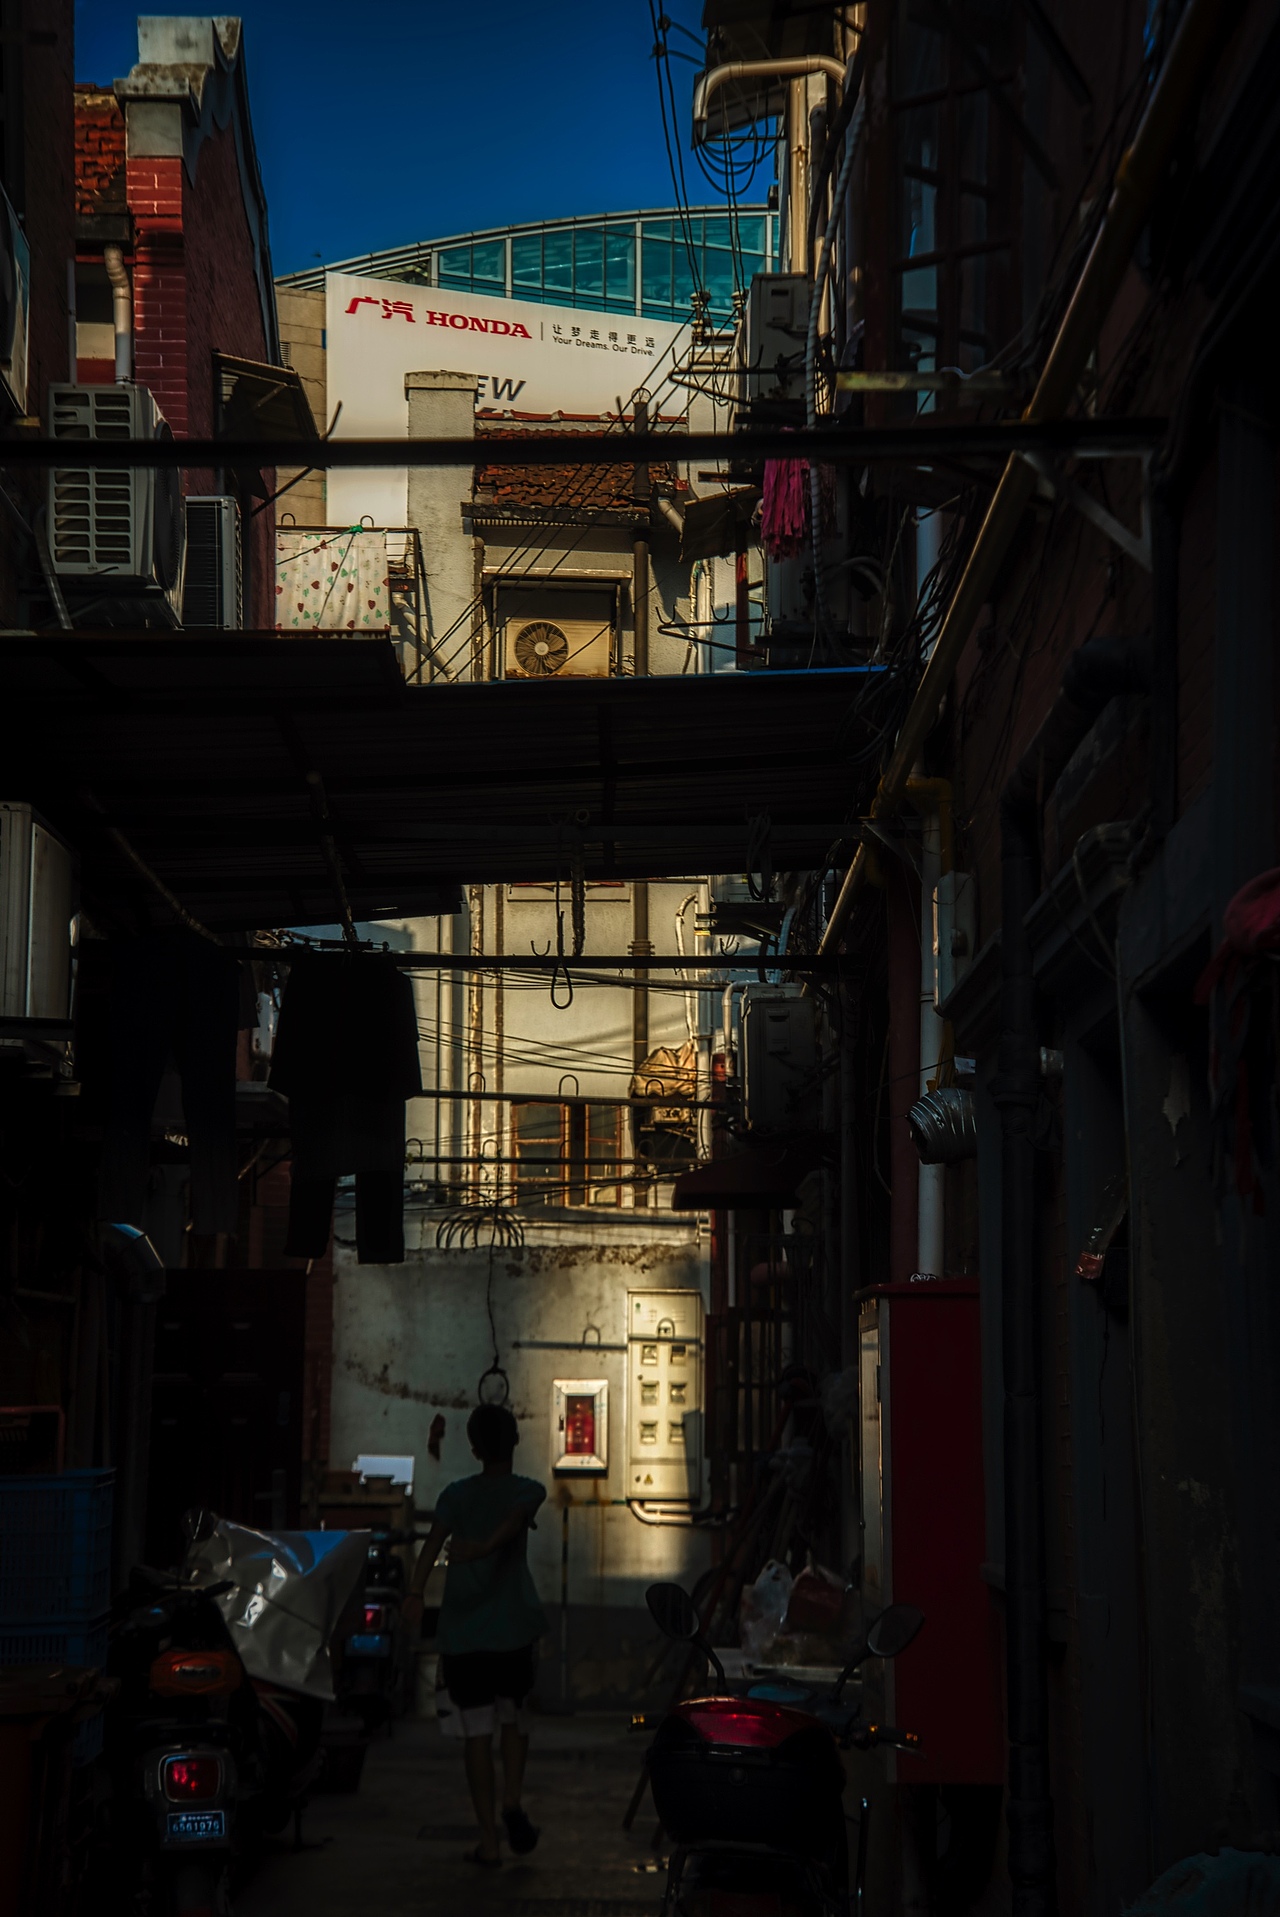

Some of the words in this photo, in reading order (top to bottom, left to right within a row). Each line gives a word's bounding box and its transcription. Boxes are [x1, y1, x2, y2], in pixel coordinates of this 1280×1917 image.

[345, 296, 416, 323] 广汽
[426, 310, 533, 339] HONDA
[552, 323, 655, 348] 让梦走得更远
[552, 335, 572, 345] Your
[575, 338, 610, 351] Dreams.
[612, 343, 628, 353] Our
[630, 346, 655, 357] Drive.
[477, 374, 528, 403] EW
